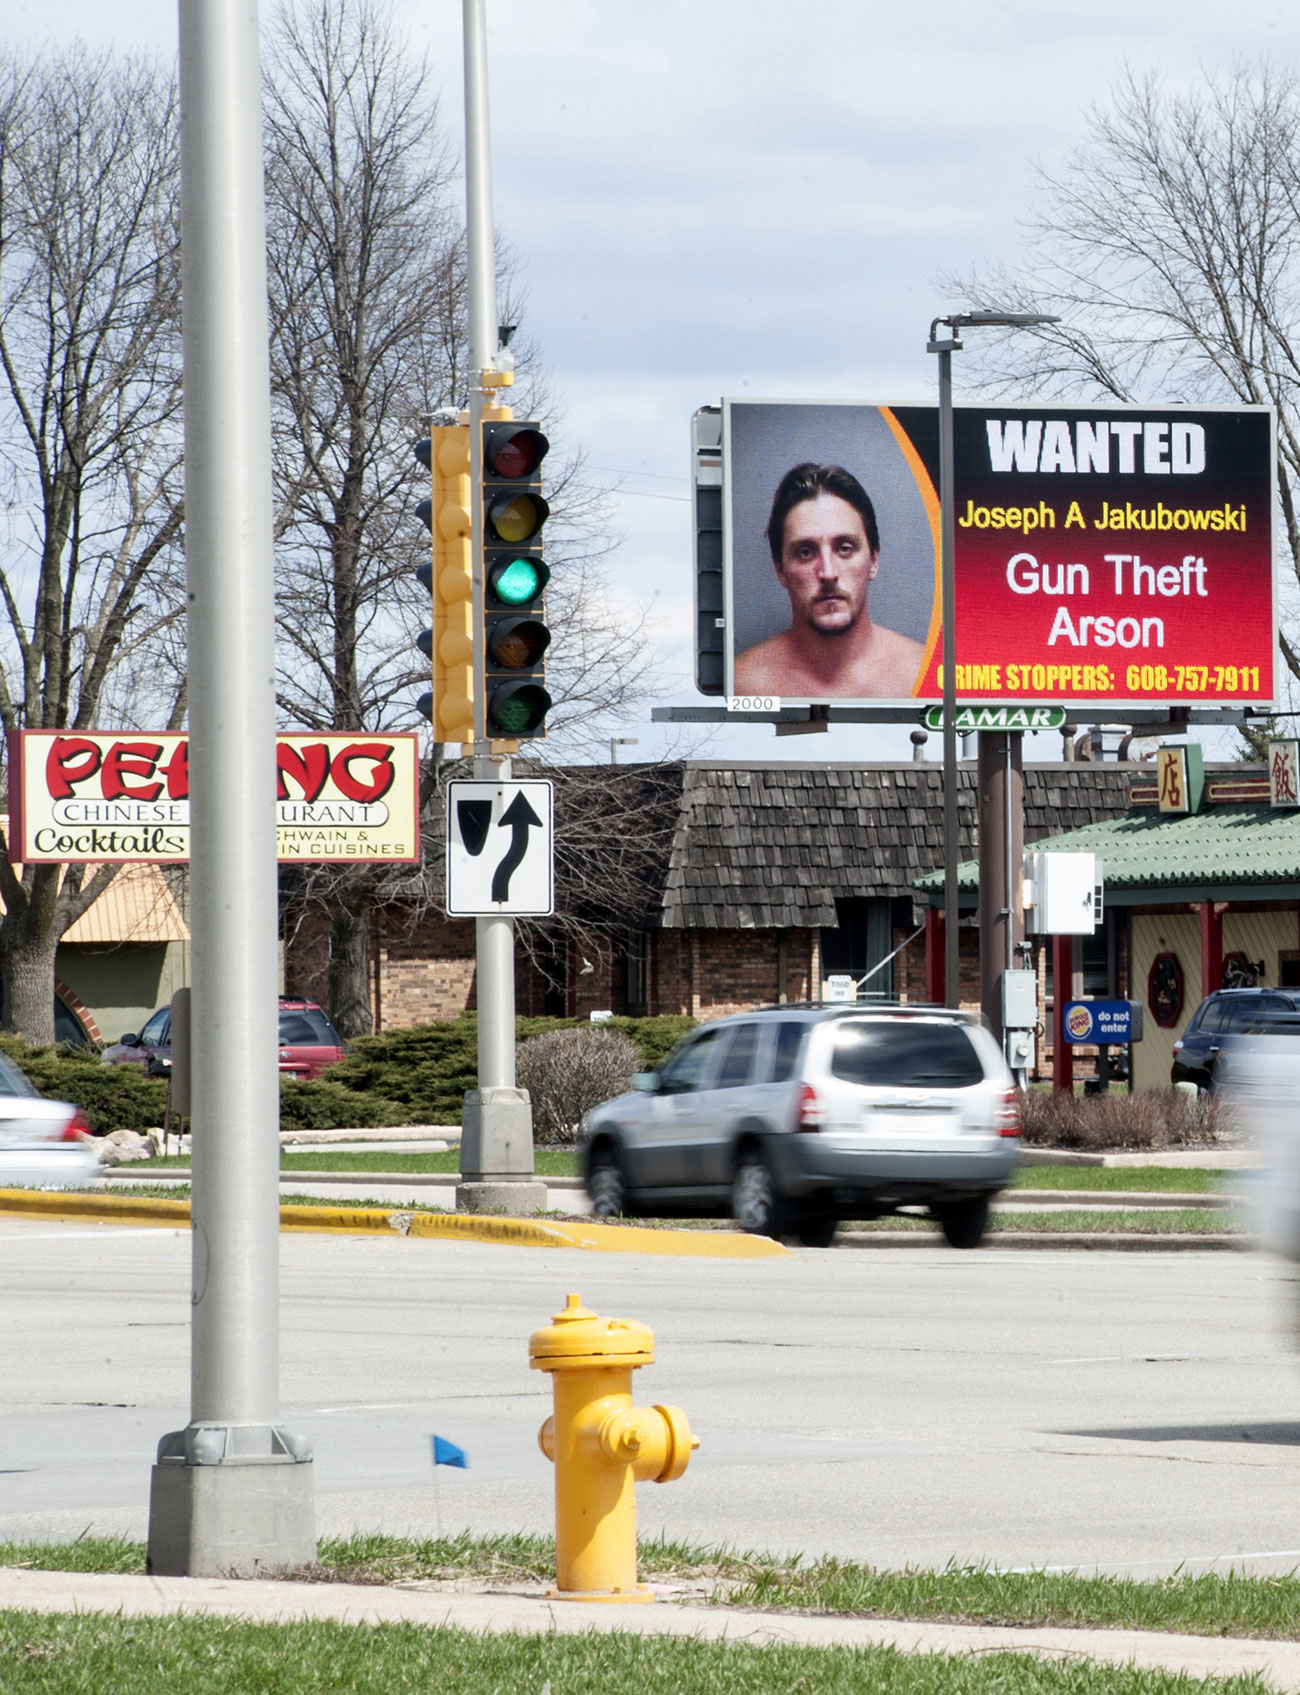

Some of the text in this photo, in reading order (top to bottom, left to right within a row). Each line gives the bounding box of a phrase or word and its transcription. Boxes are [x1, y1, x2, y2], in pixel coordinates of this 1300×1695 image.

[986, 420, 1206, 474] WANTED
[958, 500, 1247, 535] Joseph A Jakubowski
[1006, 553, 1208, 596] Gun Theft
[1047, 606, 1164, 648] Arson
[1006, 664, 1115, 691] STOPPERS:
[1126, 666, 1259, 691] 608-757-7911
[732, 698, 773, 710] 2000
[1161, 753, 1180, 807] 店
[64, 805, 182, 821] CHINESE
[34, 827, 185, 853] Cocktails
[310, 844, 405, 854] CUISINES
[357, 831, 369, 841] &
[1098, 1011, 1130, 1021] do not
[1101, 1023, 1127, 1033] enter
